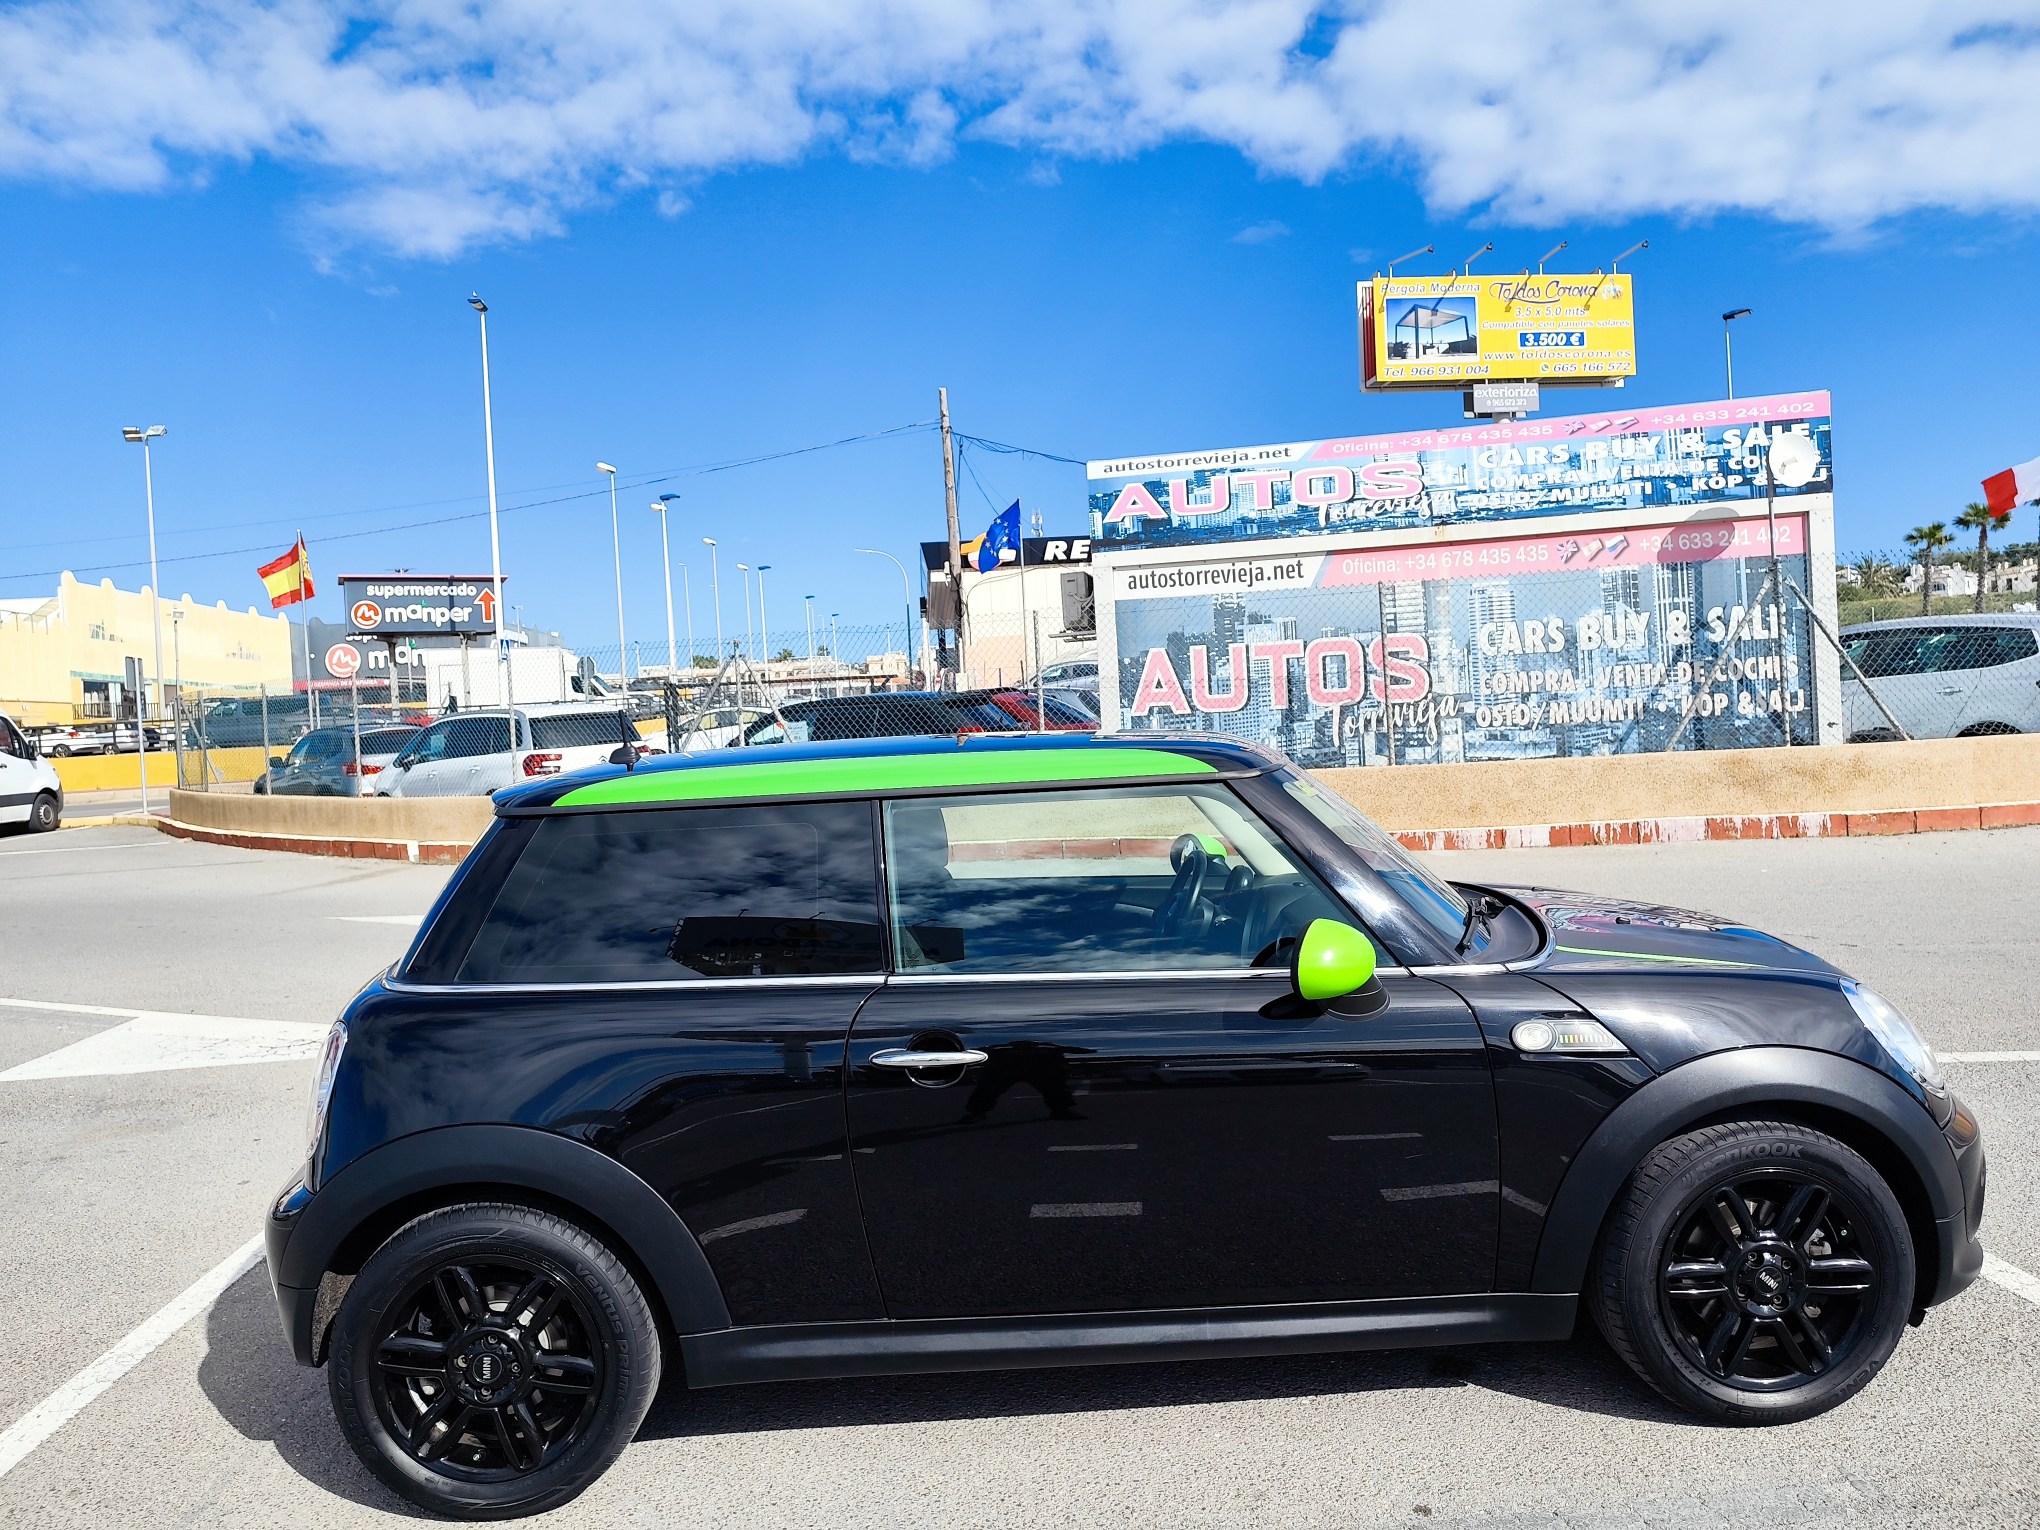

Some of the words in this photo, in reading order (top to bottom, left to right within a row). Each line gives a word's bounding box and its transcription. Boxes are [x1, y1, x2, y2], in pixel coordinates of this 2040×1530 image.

[1430, 281, 1480, 293] Moderna
[1489, 281, 1541, 303] Toldos
[1545, 280, 1599, 299] Corona
[1482, 320, 1535, 329] Compatible
[1538, 319, 1556, 327] con
[1558, 319, 1594, 328] paneles
[1597, 318, 1630, 327] solares
[1524, 333, 1567, 347] 3.500
[1569, 332, 1581, 346] €
[1483, 350, 1631, 360] www.toldoscorona.es
[1384, 367, 1406, 377] Tel.
[1411, 366, 1435, 376] 966
[1439, 366, 1461, 376] 931
[1466, 365, 1489, 375] 004
[1553, 363, 1577, 373] 665
[1582, 362, 1604, 372] 166
[1608, 362, 1631, 371] 572
[1474, 386, 1538, 398] exterioriza
[1650, 413, 1687, 425] +34
[1692, 410, 1730, 422] 633
[1735, 406, 1772, 418] 241
[1777, 402, 1815, 413] 402
[1332, 440, 1394, 454] Oficina:
[1399, 436, 1432, 446] +34
[1437, 432, 1473, 444] 678
[1478, 429, 1513, 441] 435
[1518, 425, 1554, 437] 435
[1103, 447, 1292, 474] autostorrevieja.net
[1478, 444, 1571, 469] CARS
[1585, 436, 1662, 460] BUY
[1477, 469, 1582, 491] COMPRA
[1607, 461, 1682, 484] VENTA
[1688, 458, 1719, 474] DE
[1103, 461, 1424, 523] AUTOS
[1044, 540, 1091, 561] RE
[1640, 535, 1674, 551] +34
[1678, 532, 1713, 550] 633
[1718, 528, 1752, 547] 241
[1343, 557, 1400, 575] Oficina:
[1405, 554, 1436, 570] +34
[1441, 550, 1473, 568] 678
[1478, 547, 1511, 565] 435
[1515, 544, 1549, 562] 435
[1128, 559, 1304, 590] autostorrevieja.net
[366, 583, 478, 599] supermercado
[384, 604, 473, 627] manper
[1479, 617, 1566, 656] CARS
[1578, 611, 1651, 650] BUY
[1666, 610, 1694, 645] &
[1131, 633, 1430, 716] AUTOS
[1479, 668, 1577, 695] COMPRA
[1600, 663, 1668, 688] VENTA
[1677, 660, 1706, 684] DE
[1759, 1271, 1779, 1290] MINI
[482, 1357, 492, 1379] MINI
